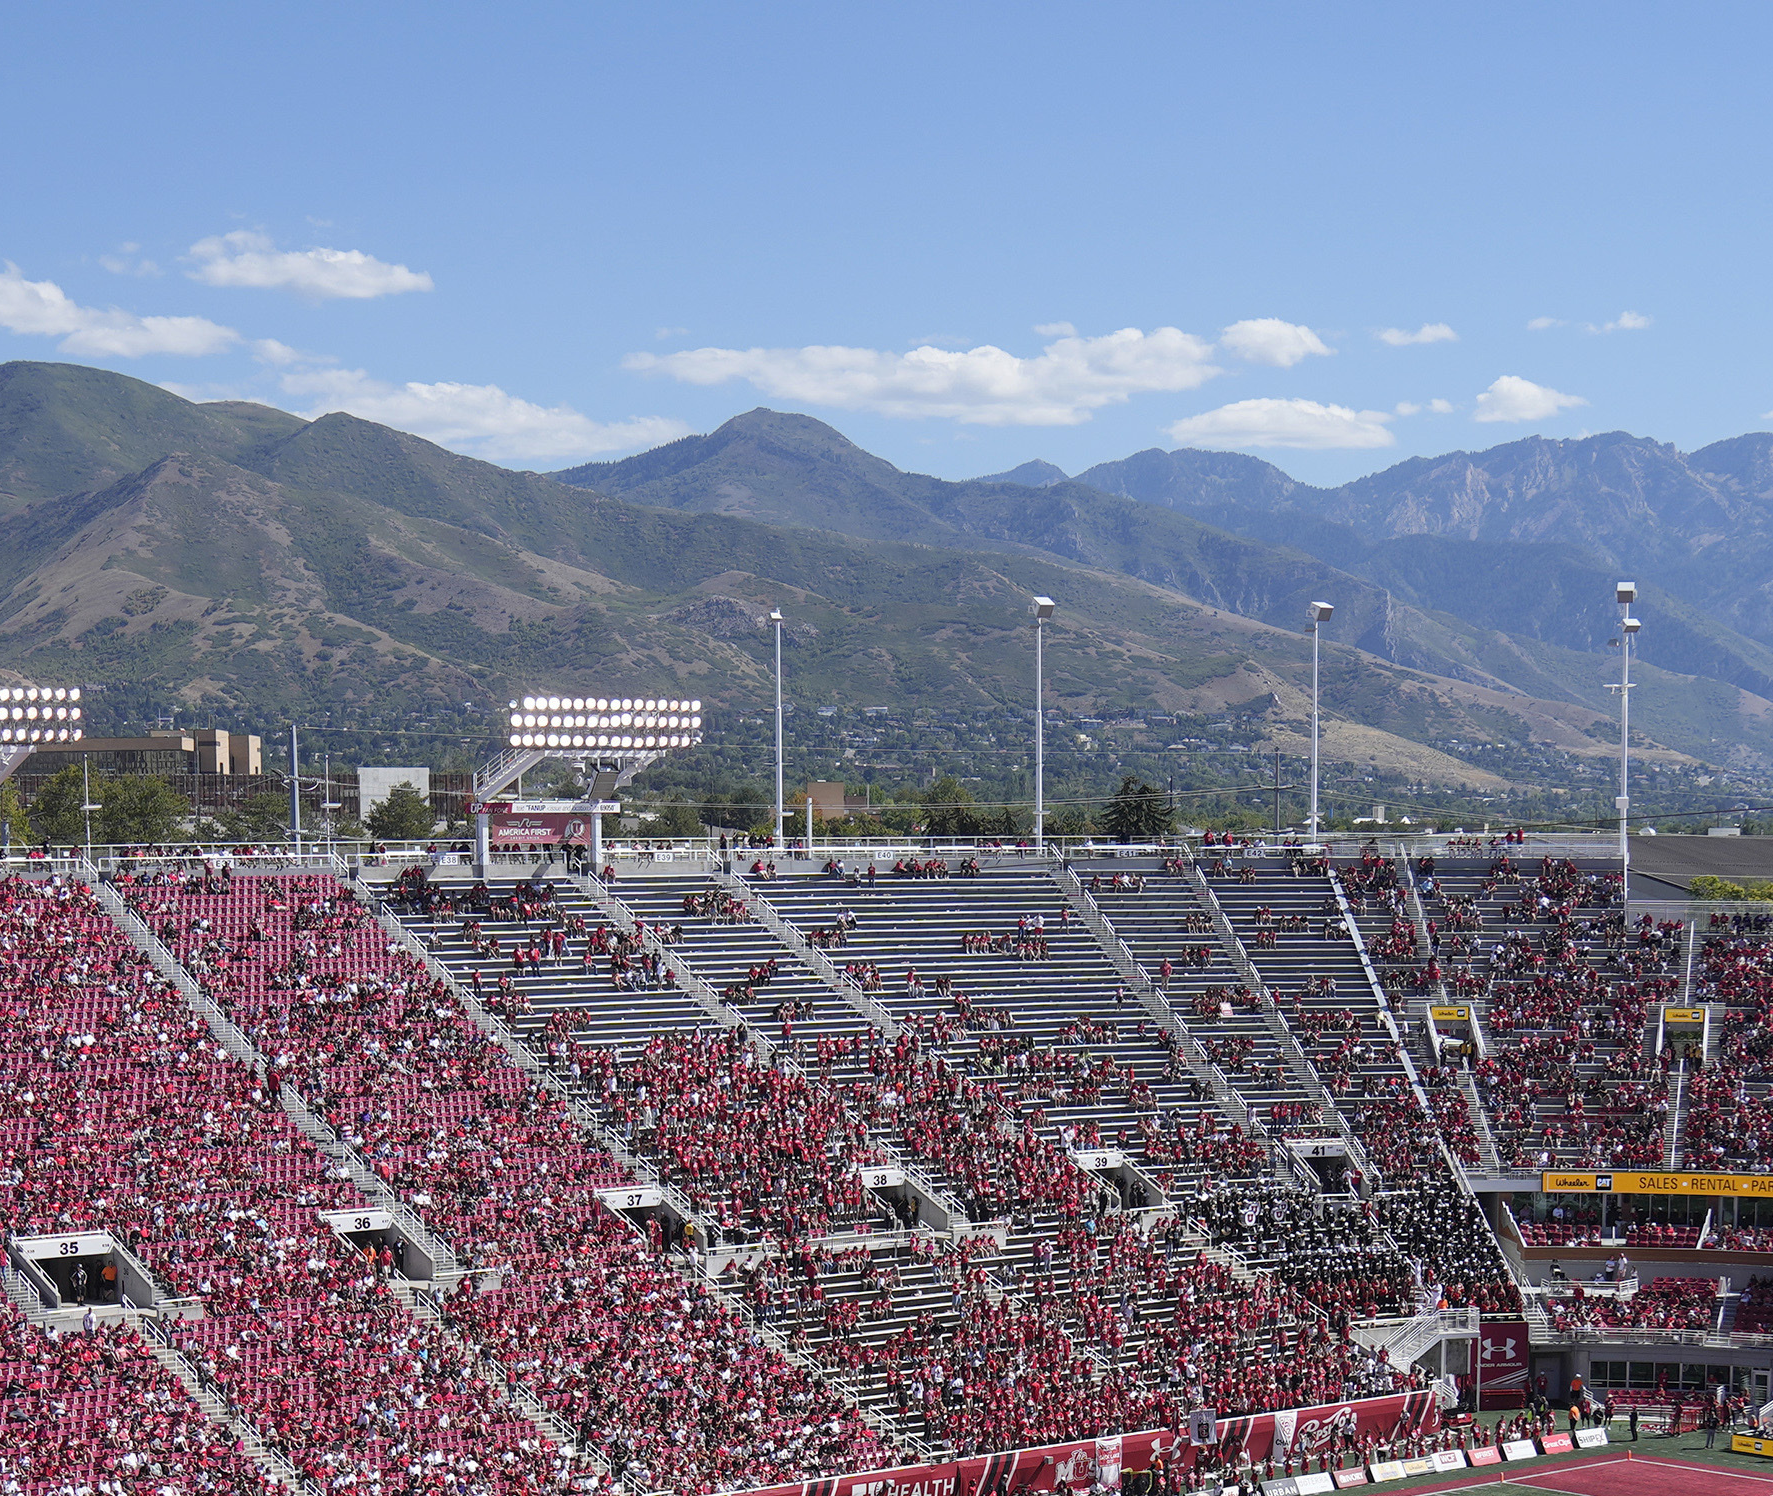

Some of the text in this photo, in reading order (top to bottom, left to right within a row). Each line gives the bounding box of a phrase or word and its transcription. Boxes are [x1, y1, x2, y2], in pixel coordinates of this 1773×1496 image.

[498, 828, 552, 837] AMERICA FIRST
[656, 854, 671, 862] E39
[877, 851, 892, 859] E40
[1247, 849, 1263, 857] E42
[441, 857, 457, 865] E38
[1312, 1145, 1325, 1157] 41
[1094, 1157, 1108, 1168] 39
[873, 1174, 888, 1187] 38
[1555, 1177, 1612, 1189] Wheeler CAT
[1639, 1176, 1678, 1190] SALES
[1690, 1177, 1738, 1192] RENTAL
[626, 1194, 643, 1207] 37
[355, 1216, 371, 1230] 36
[60, 1240, 79, 1255] 35
[1543, 1439, 1558, 1448] Great
[1578, 1434, 1604, 1447] SHIPEX
[1440, 1453, 1456, 1464] WCF
[1474, 1450, 1494, 1459] UFIRST
